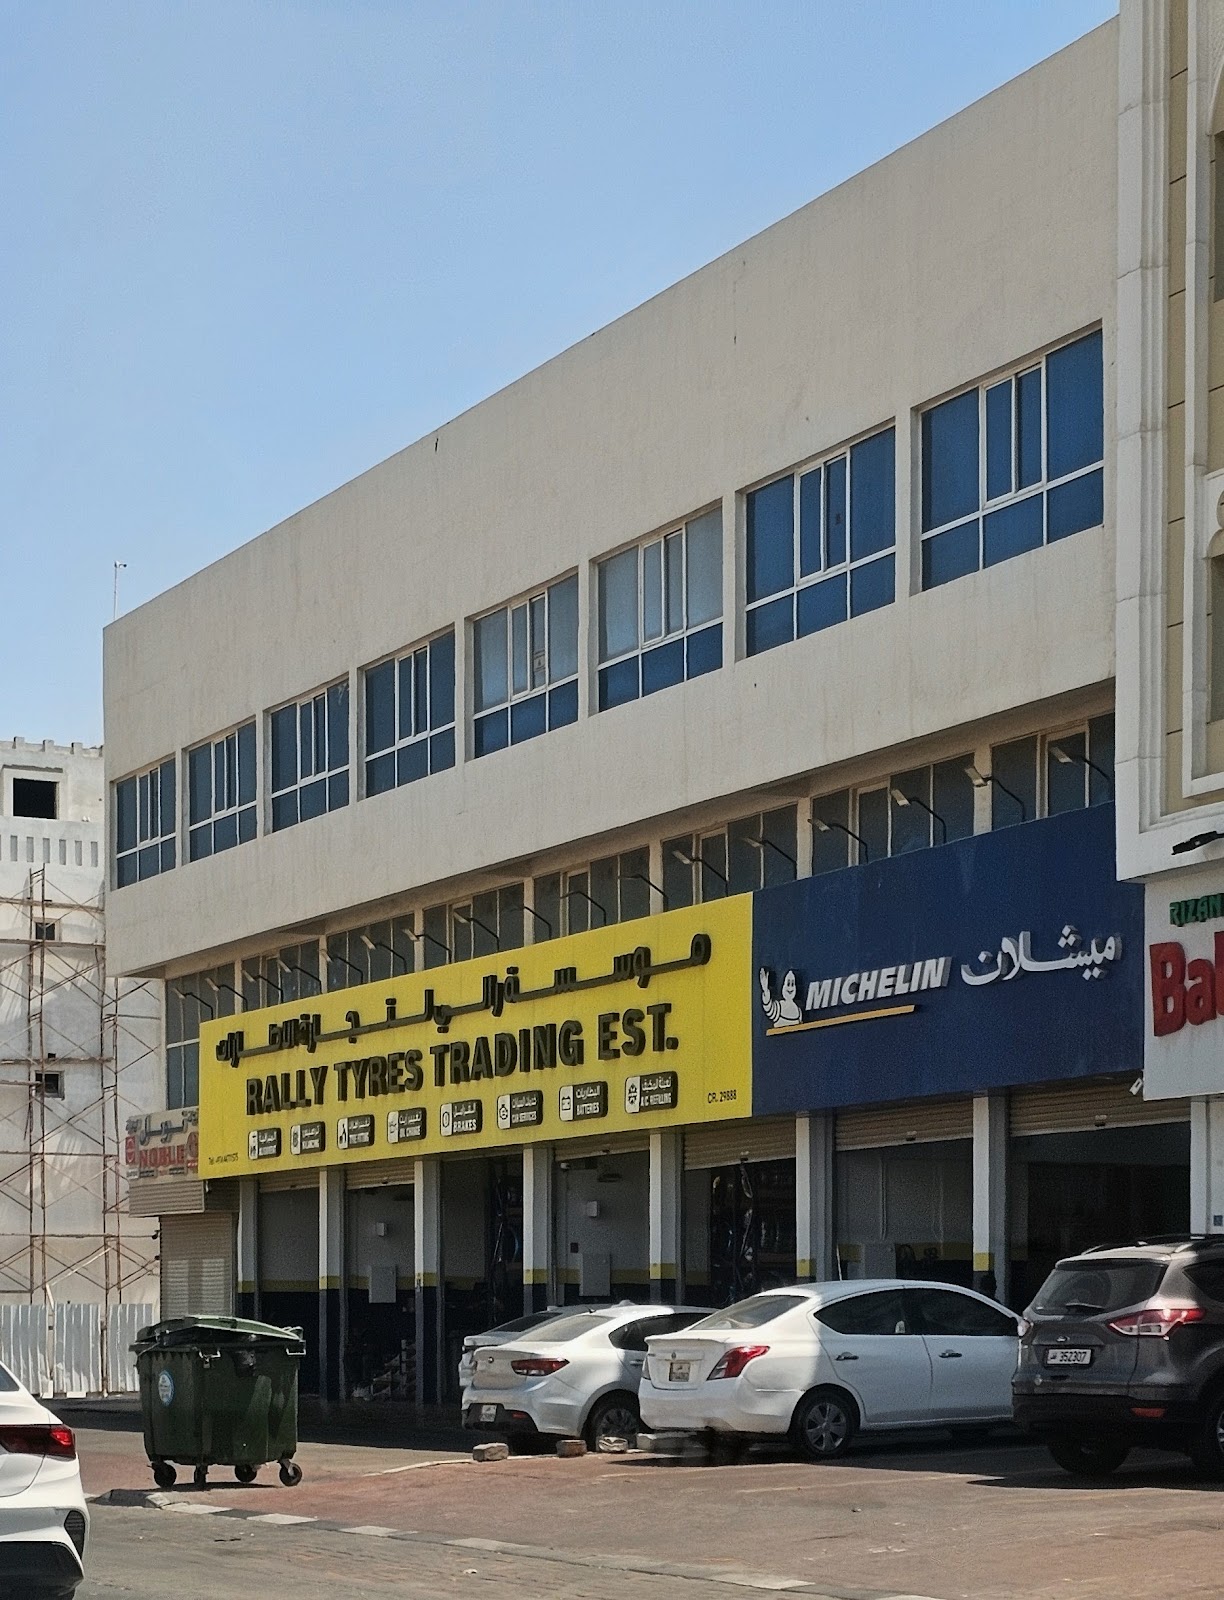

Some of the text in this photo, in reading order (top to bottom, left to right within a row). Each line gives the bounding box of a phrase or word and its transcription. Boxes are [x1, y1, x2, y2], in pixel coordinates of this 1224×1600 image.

[961, 925, 1121, 986] ميشلان
[805, 957, 950, 1010] MICHELIN
[246, 1003, 679, 1116] RALLY TYRES TRADING EST.
[453, 1119, 477, 1133] BRAKES
[577, 1102, 600, 1115] BATTERIES
[140, 1145, 185, 1169] NOBLE
